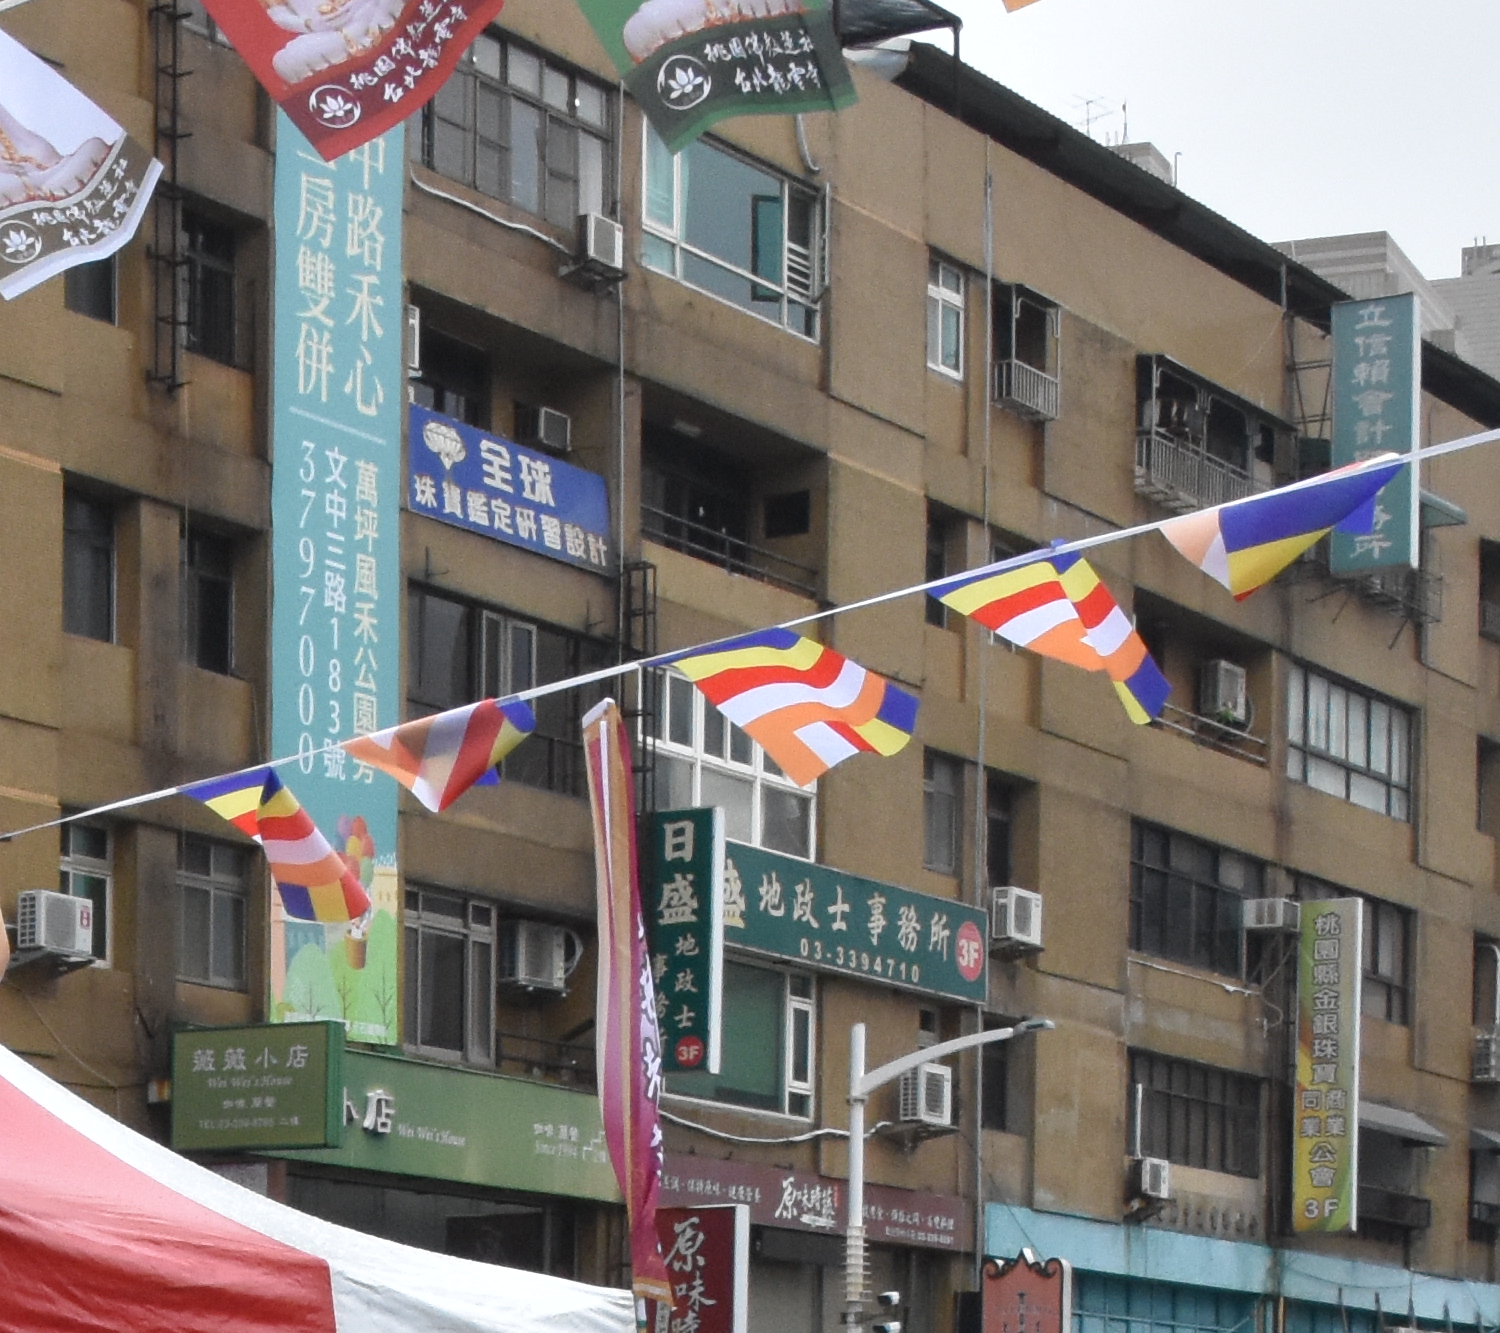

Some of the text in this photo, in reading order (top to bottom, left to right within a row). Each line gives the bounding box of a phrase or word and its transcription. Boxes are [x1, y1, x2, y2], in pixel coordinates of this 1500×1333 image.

[480, 439, 556, 507] 全球
[657, 818, 699, 926] 日盛
[799, 937, 920, 984] 03-3394710
[958, 938, 979, 968] 3F
[673, 933, 699, 1029] 地政士
[677, 1044, 700, 1060] 3F
[1303, 1198, 1339, 1219] 3F
